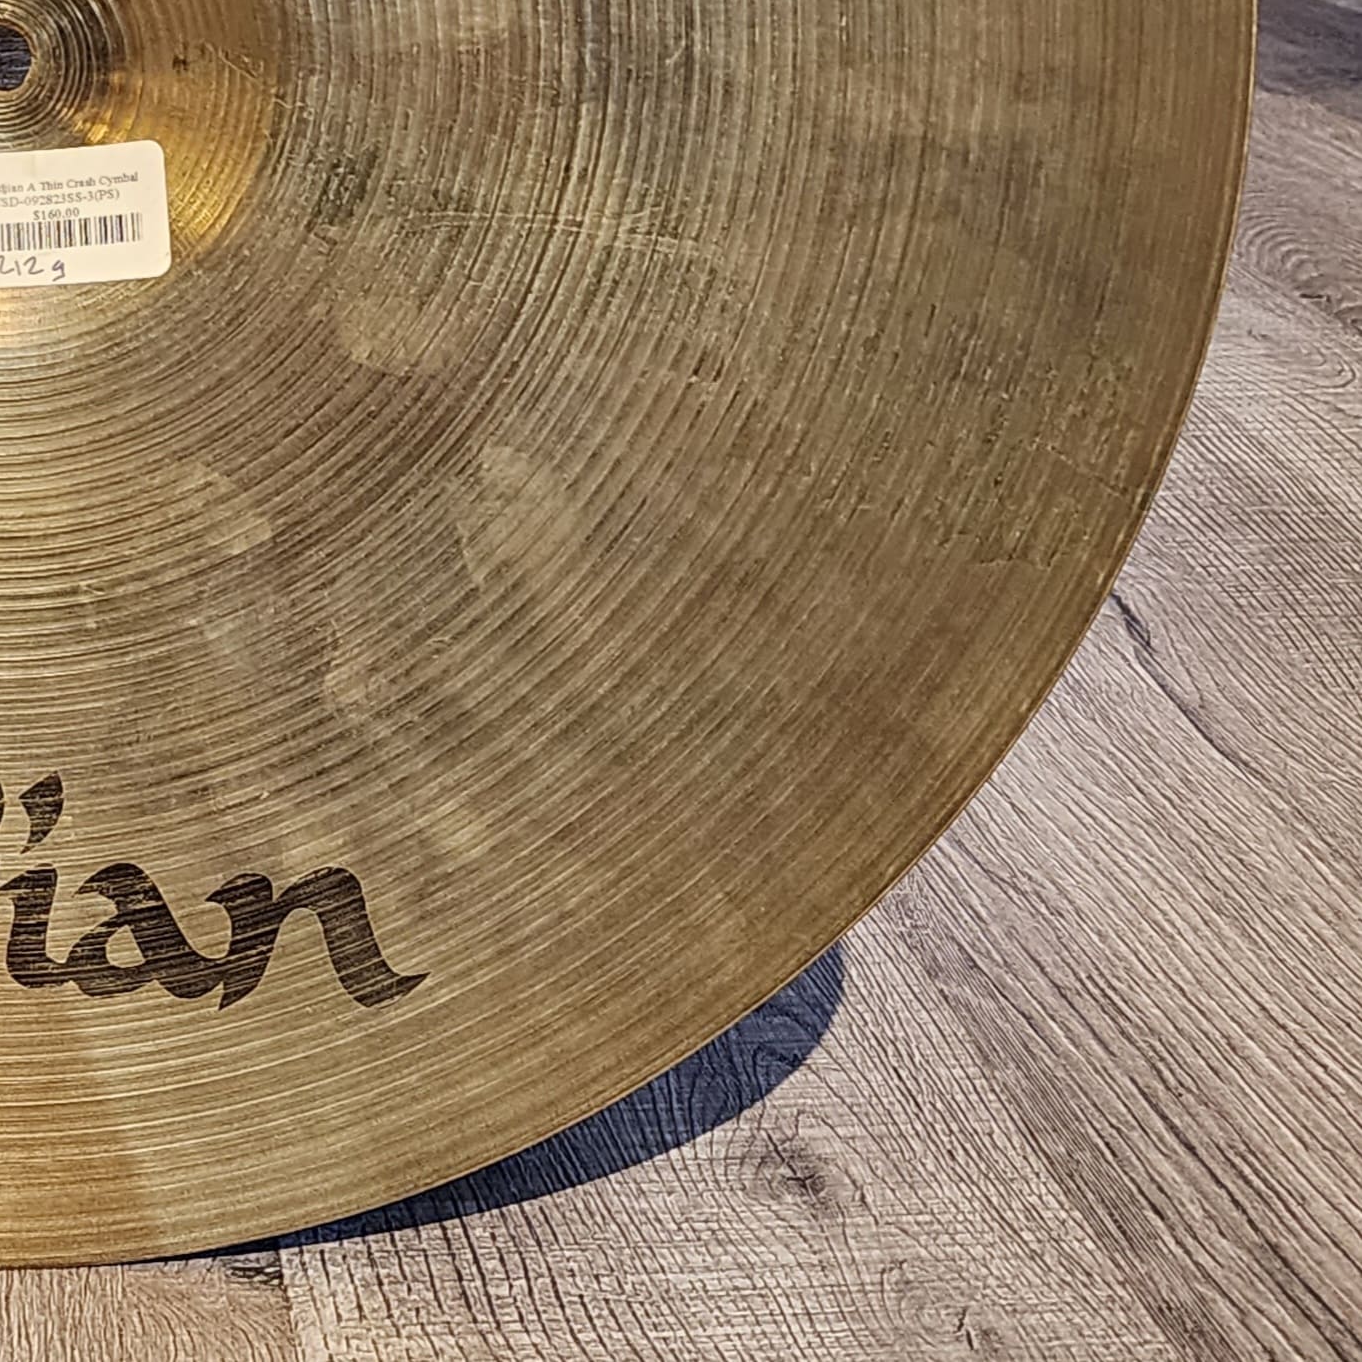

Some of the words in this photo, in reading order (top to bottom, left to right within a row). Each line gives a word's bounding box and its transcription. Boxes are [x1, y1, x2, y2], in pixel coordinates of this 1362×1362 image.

[26, 183, 36, 192] A
[40, 180, 63, 191] Thin
[66, 177, 96, 188] Crash
[99, 171, 138, 187] Cymbal
[33, 207, 80, 220] $160.00
